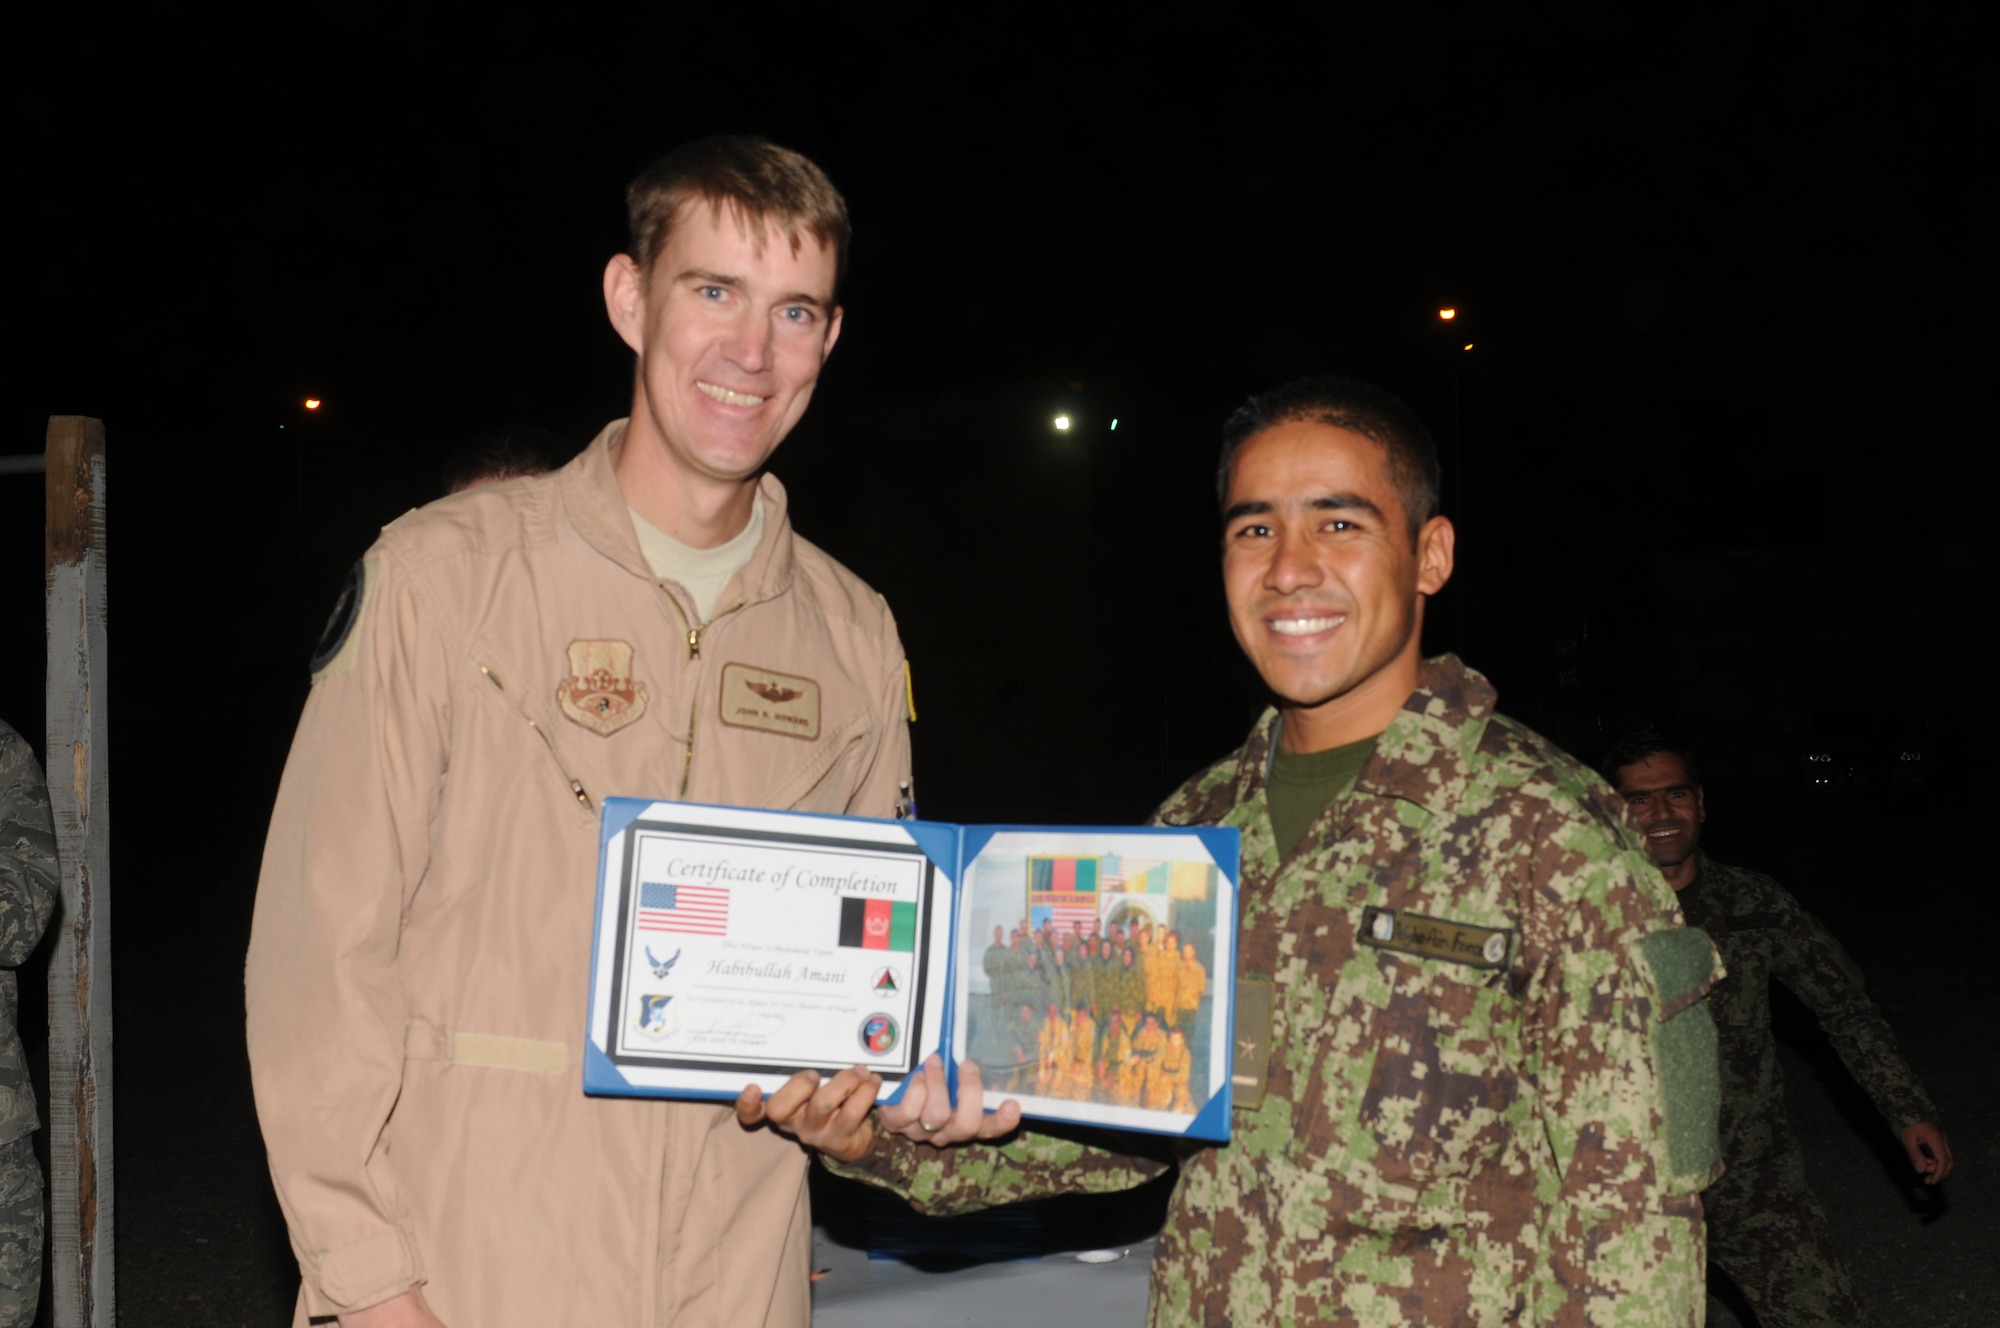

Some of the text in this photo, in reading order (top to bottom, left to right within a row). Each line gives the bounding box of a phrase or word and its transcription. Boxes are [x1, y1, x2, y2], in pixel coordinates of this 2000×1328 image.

[667, 858, 897, 896] Certificate of Completion
[706, 959, 847, 983] Habibullah Amani
